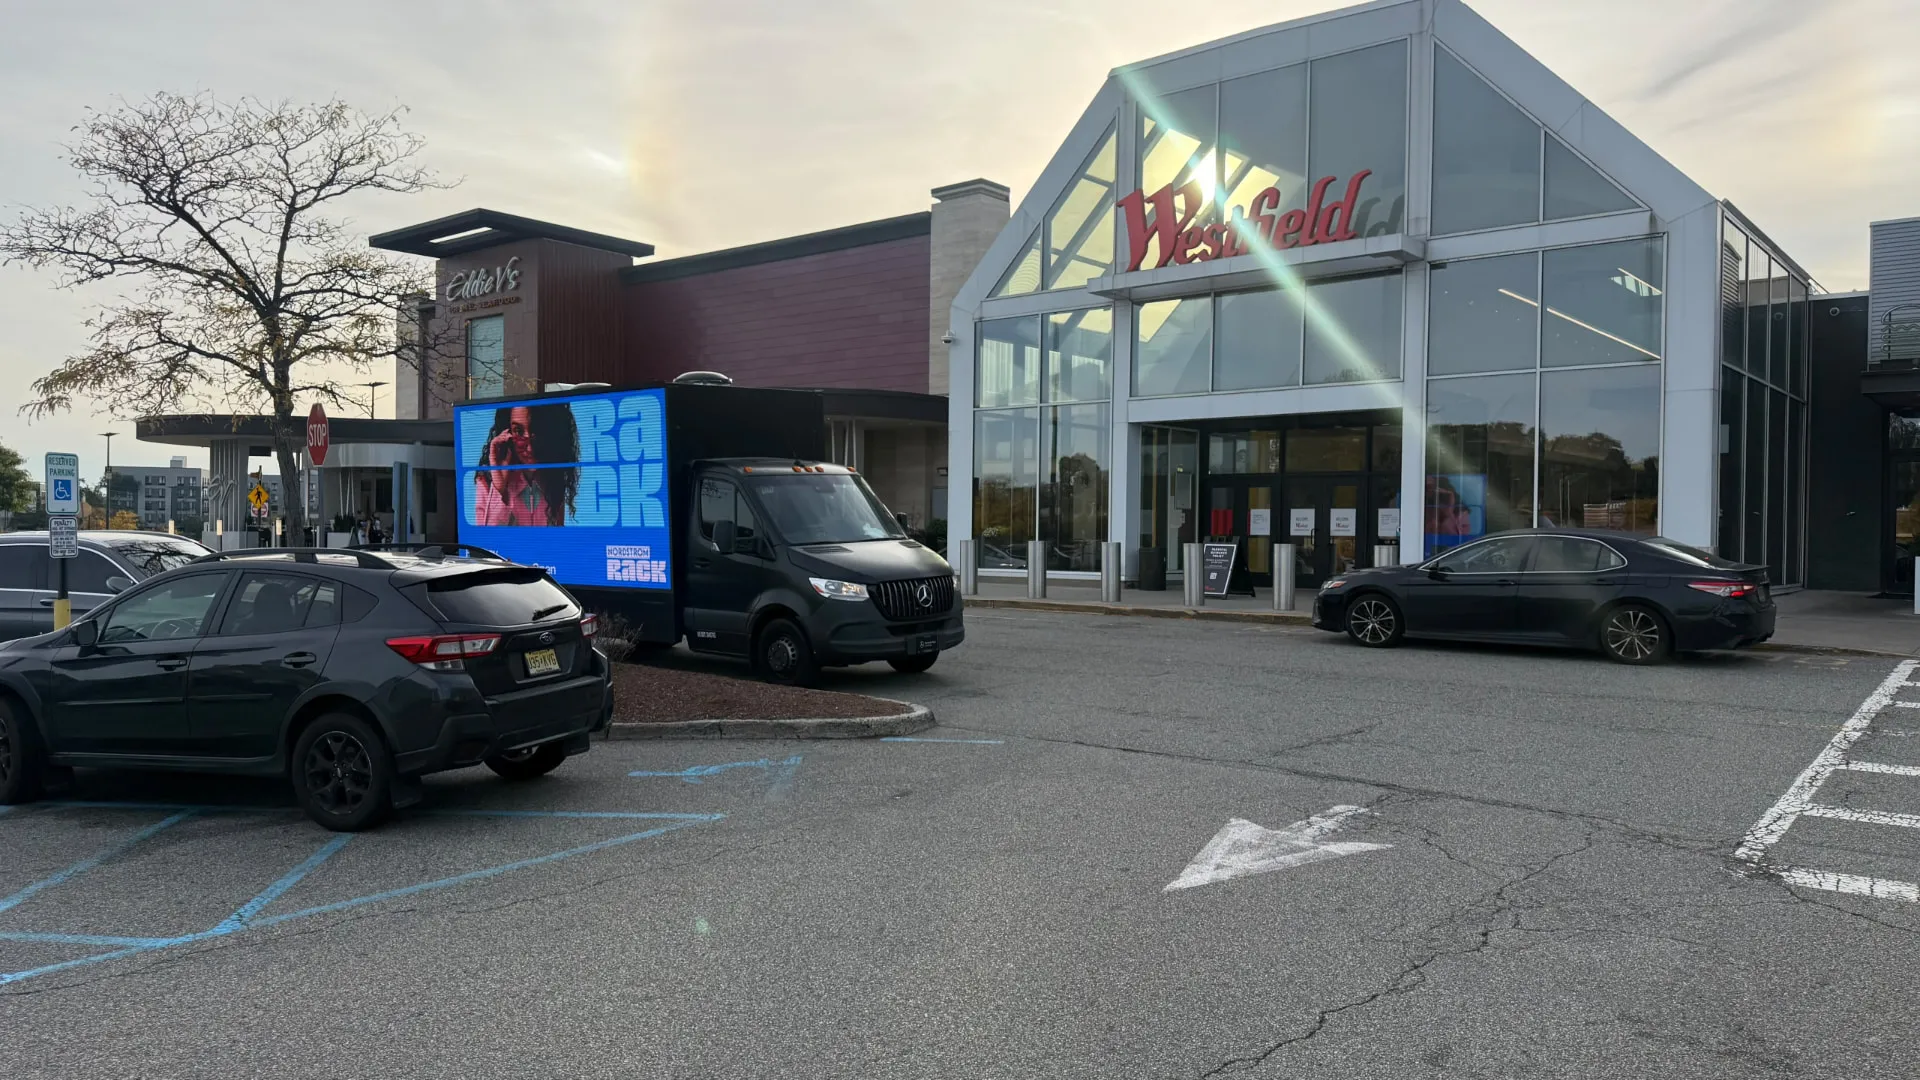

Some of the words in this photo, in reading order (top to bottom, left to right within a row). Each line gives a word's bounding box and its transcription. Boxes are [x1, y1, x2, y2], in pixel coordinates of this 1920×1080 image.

[1116, 169, 1372, 272] Westfield
[446, 268, 494, 301] Eddie
[496, 256, 519, 293] V's
[308, 421, 328, 447] STOP
[48, 457, 76, 467] RESERVED
[49, 468, 75, 477] PARKING
[608, 547, 649, 557] NORDSTROM
